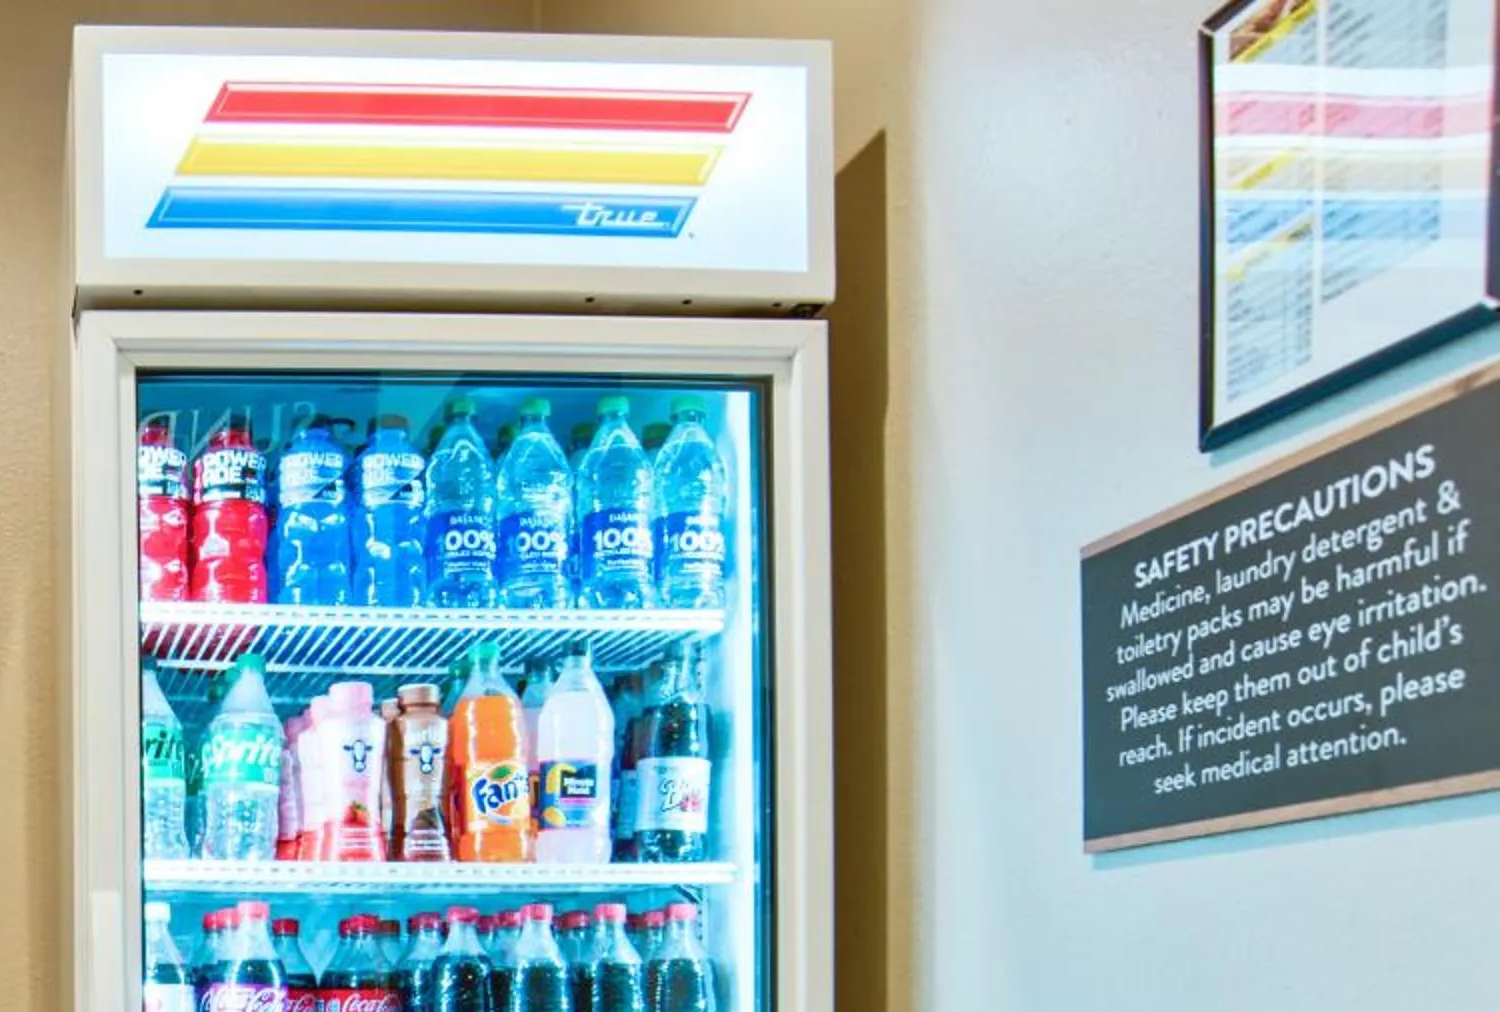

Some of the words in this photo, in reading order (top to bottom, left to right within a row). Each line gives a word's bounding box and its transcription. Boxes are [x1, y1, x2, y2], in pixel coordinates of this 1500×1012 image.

[1120, 583, 1211, 629] Medicine,
[1216, 550, 1298, 596] laundry
[1301, 497, 1428, 564] detergent
[1436, 479, 1462, 516] &
[1133, 532, 1222, 589] SAFETY
[1223, 444, 1436, 555] PRECAUTIONS
[1105, 654, 1195, 703] swallowed
[1199, 645, 1236, 675] and
[1241, 625, 1301, 664] cause
[1308, 607, 1351, 649] eye
[1358, 573, 1488, 627] irritation.
[1116, 629, 1182, 665] toiletry
[1187, 608, 1244, 653] packs
[1248, 591, 1295, 624] may
[1300, 577, 1330, 604] be
[1336, 528, 1440, 593] harmful
[1447, 519, 1471, 555] if
[1119, 737, 1172, 768] reach.
[1179, 725, 1197, 754] If
[1198, 712, 1282, 746] incident
[1287, 690, 1372, 729] occurs,
[1380, 666, 1466, 718] please
[1120, 702, 1177, 732] Please
[1182, 685, 1230, 718] keep
[1234, 668, 1291, 702] them
[1298, 655, 1338, 686] out
[1344, 640, 1372, 675] of
[1377, 614, 1463, 665] child's
[1154, 763, 1197, 795] seek
[1201, 743, 1281, 786] medical
[1287, 723, 1408, 766] attention.
